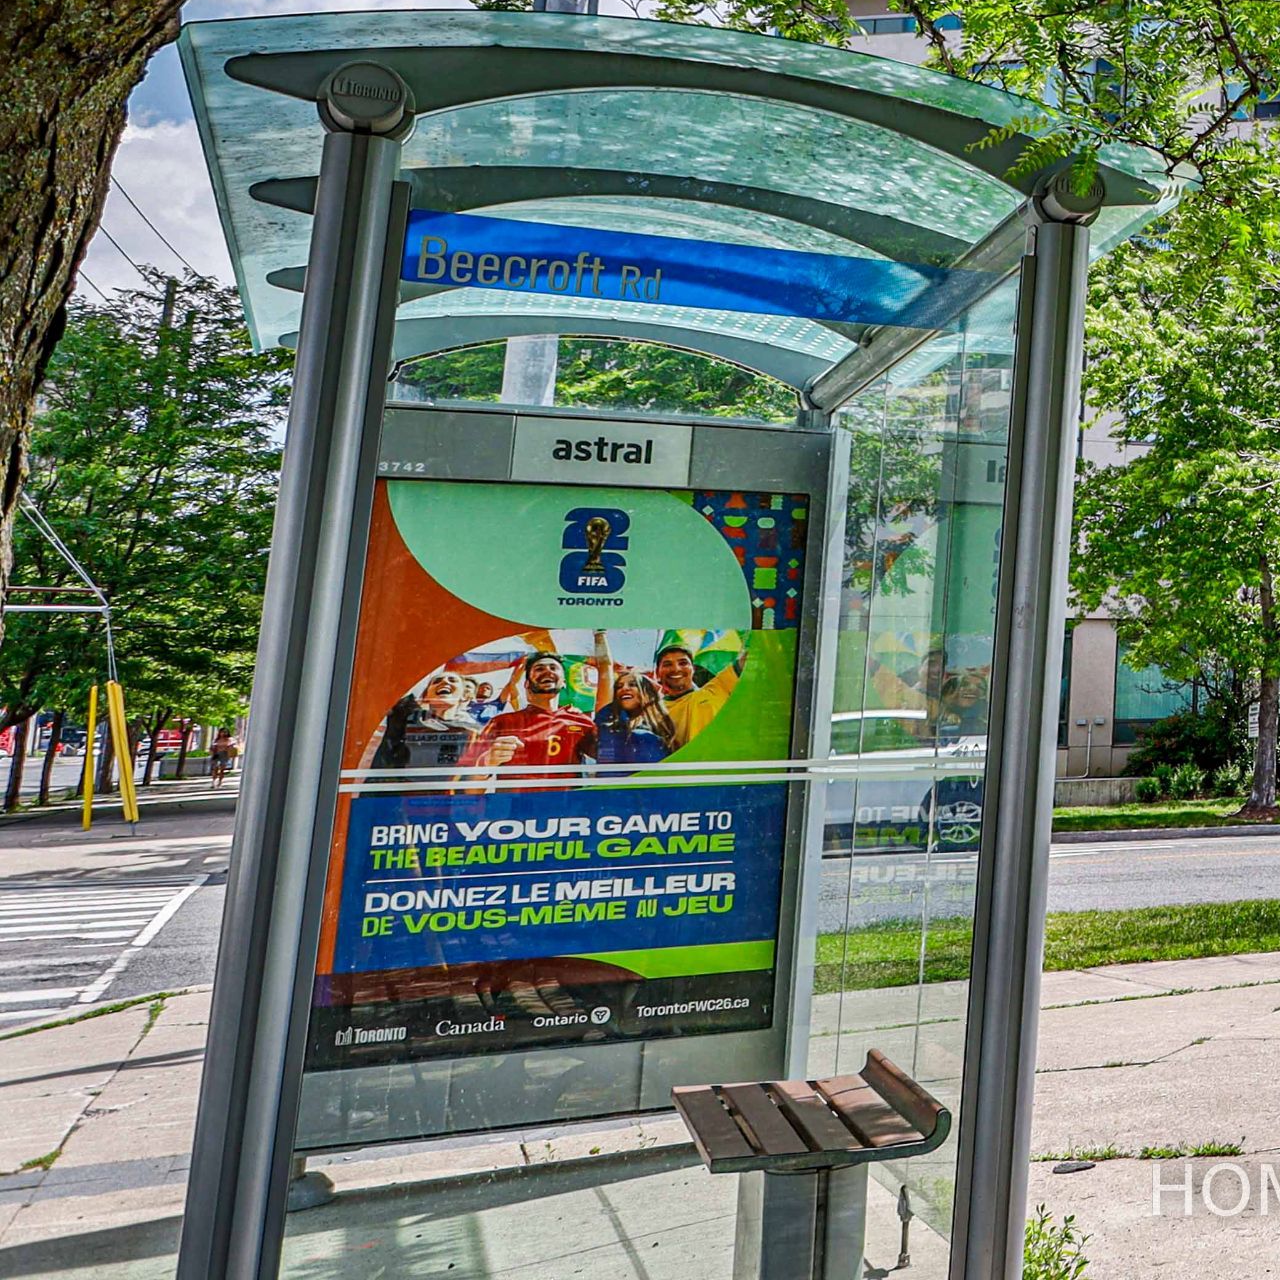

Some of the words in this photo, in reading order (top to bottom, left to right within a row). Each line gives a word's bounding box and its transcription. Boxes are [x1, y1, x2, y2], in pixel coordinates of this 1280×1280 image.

[417, 236, 605, 296] Beecroft
[621, 265, 662, 301] Rd
[552, 436, 653, 464] astral
[378, 462, 425, 472] 3742
[577, 576, 608, 587] FIFA
[557, 597, 624, 607] TORONTO
[547, 735, 562, 757] 6
[371, 823, 448, 846] BRING
[455, 817, 591, 842] YOUR
[596, 812, 701, 835] GAME
[705, 811, 732, 831] TO
[369, 847, 420, 870] THE
[425, 839, 591, 867] BEAUTIFUL
[597, 833, 736, 858] GAME
[364, 885, 507, 913] DONNEZ
[511, 882, 551, 904] LE
[555, 872, 736, 901] MEILLEUR
[361, 916, 395, 937] DE
[403, 900, 627, 933] VOUS-MÊME
[635, 898, 658, 918] AU
[662, 894, 733, 917] JEU
[636, 997, 750, 1019] TorontoFWC26.ca
[435, 1016, 506, 1037] Canada
[533, 1013, 588, 1028] Ontario
[354, 1026, 407, 1045] TORONTO
